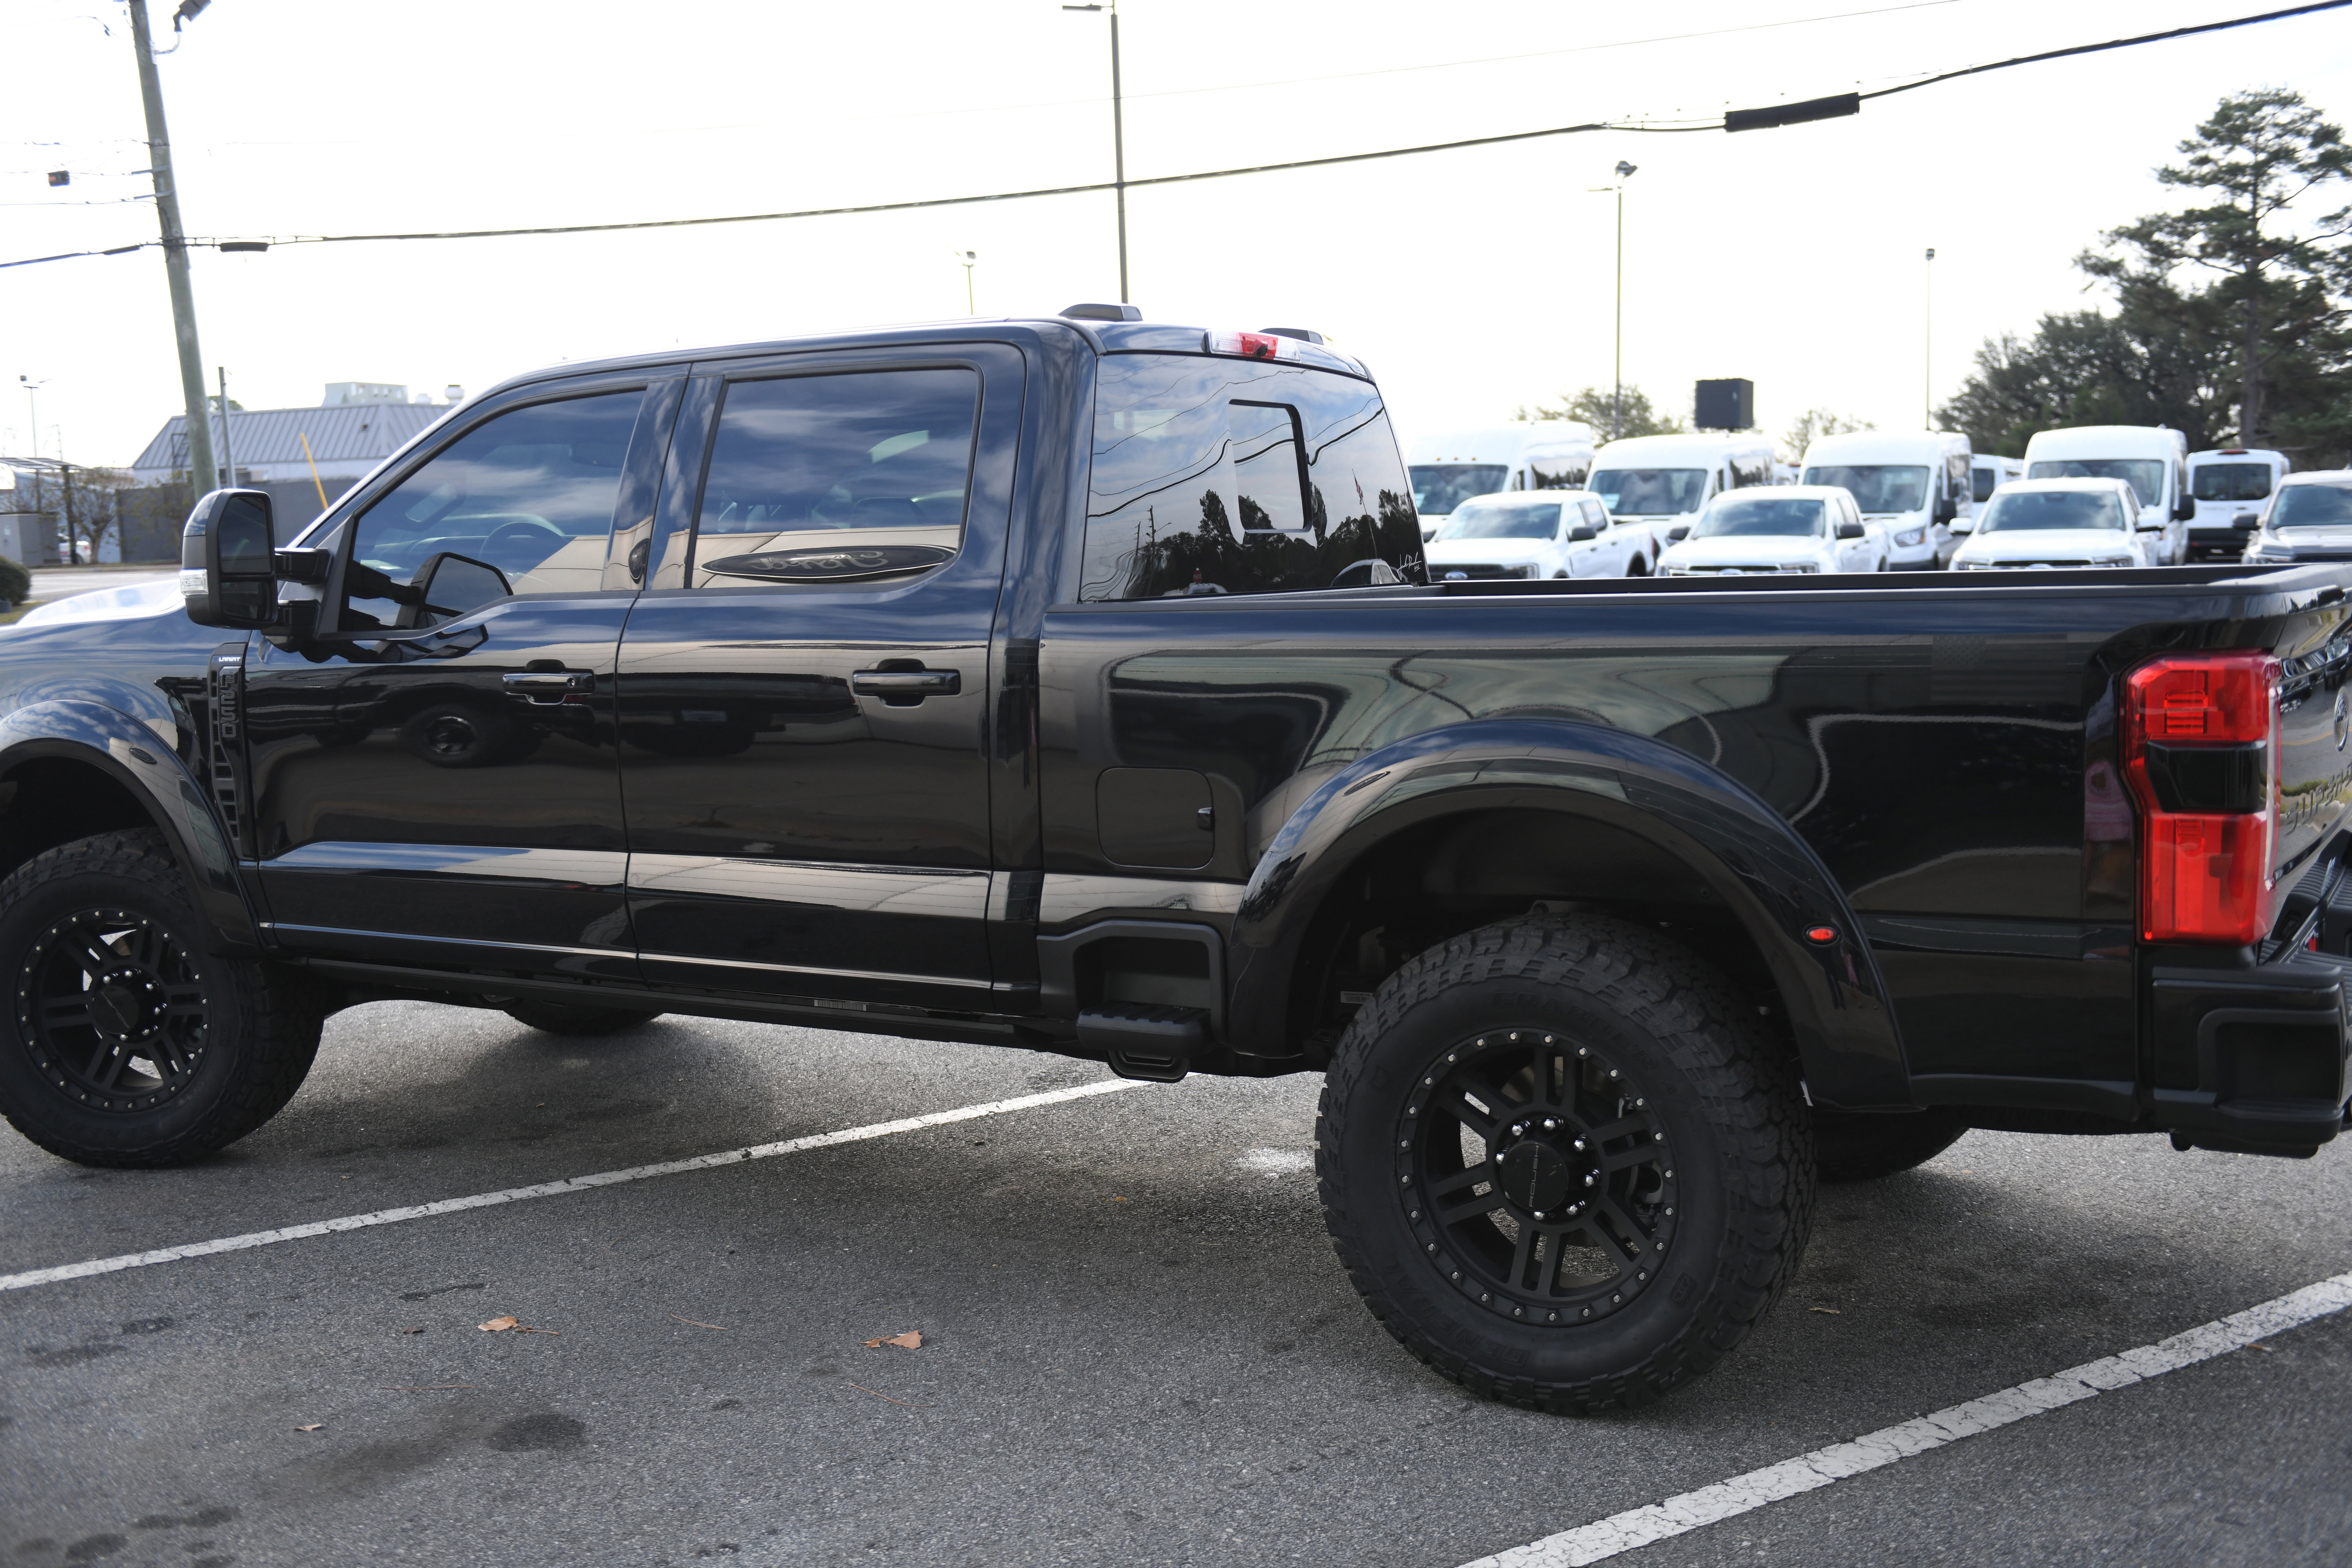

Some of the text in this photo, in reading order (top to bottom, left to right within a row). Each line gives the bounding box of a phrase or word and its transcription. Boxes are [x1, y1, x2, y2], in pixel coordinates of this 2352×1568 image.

[2283, 768, 2343, 837] SUPER
[1493, 992, 1657, 1071] GRABBER
[1529, 1145, 1539, 1207] ROUSH
[1384, 1252, 1530, 1366] GENERAL
